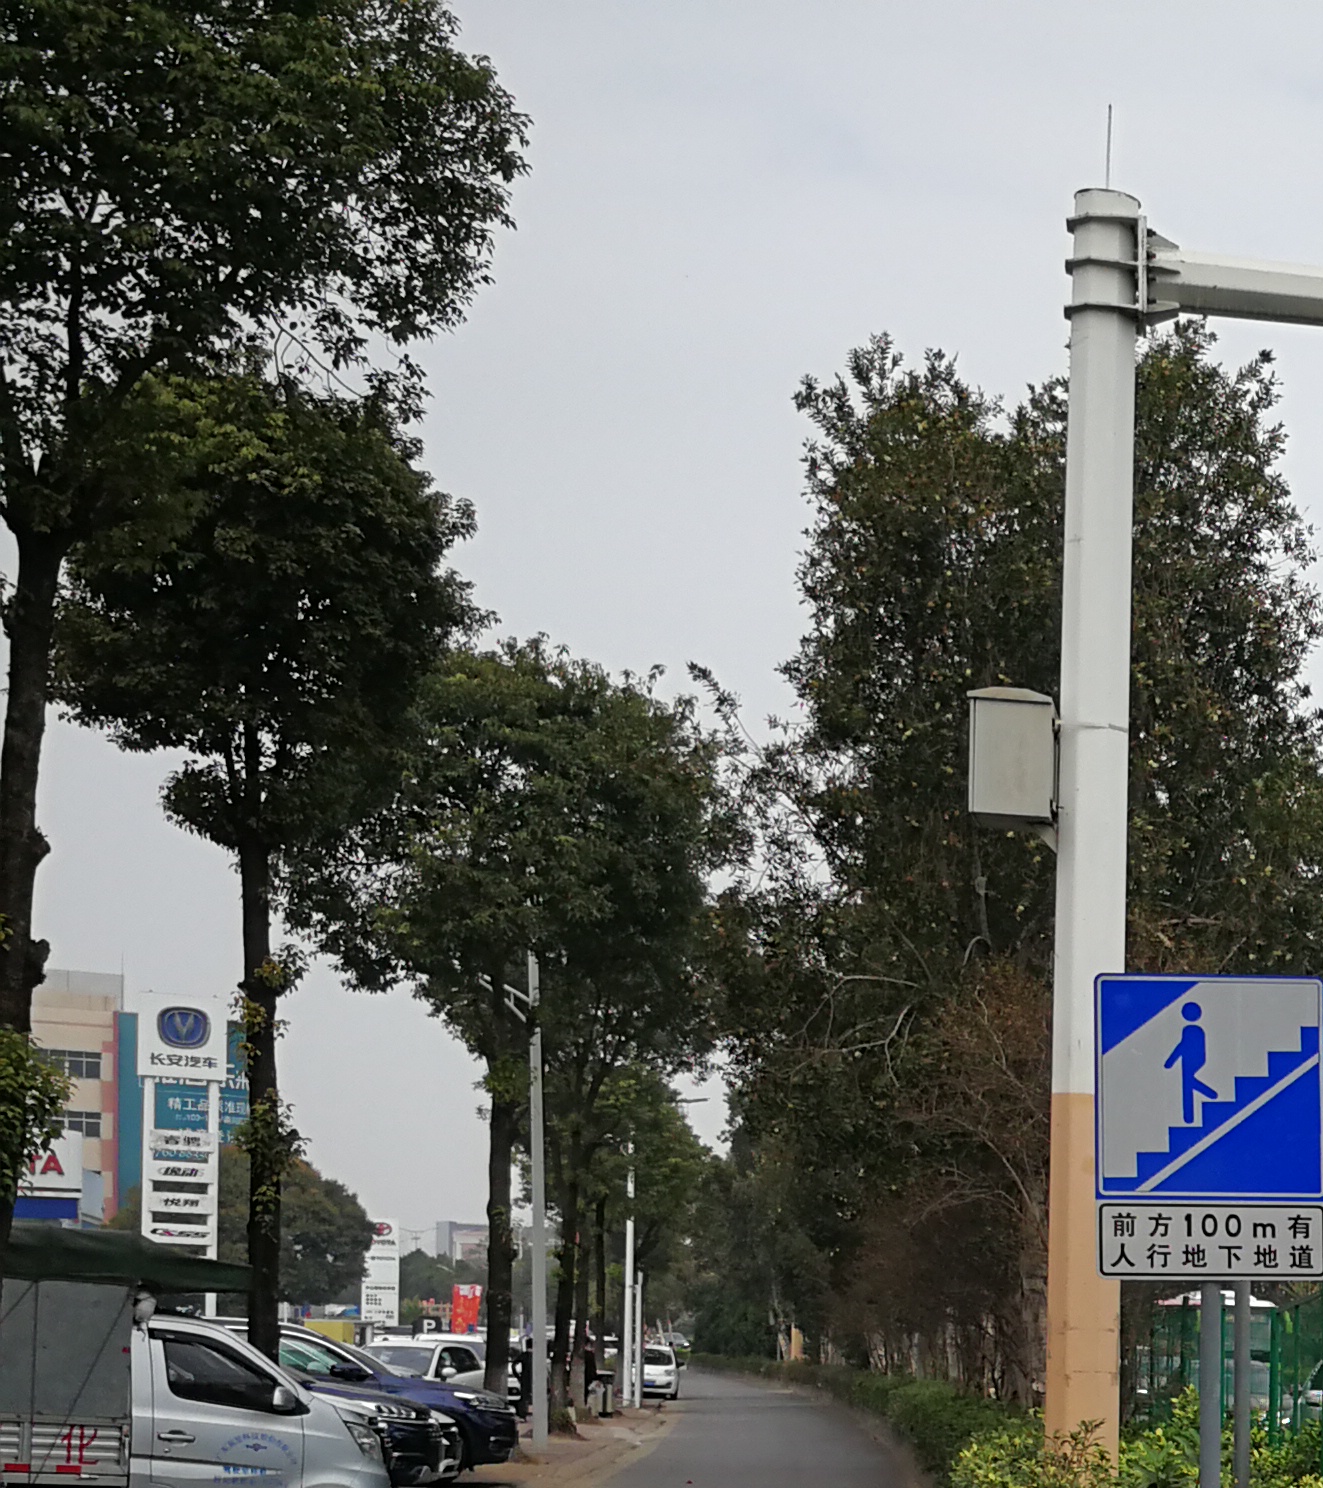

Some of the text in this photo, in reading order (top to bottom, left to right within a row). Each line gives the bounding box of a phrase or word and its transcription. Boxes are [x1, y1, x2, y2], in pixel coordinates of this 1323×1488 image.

[150, 1052, 218, 1068] 长安汽车
[1111, 1243, 1314, 1270] 人行地下地道
